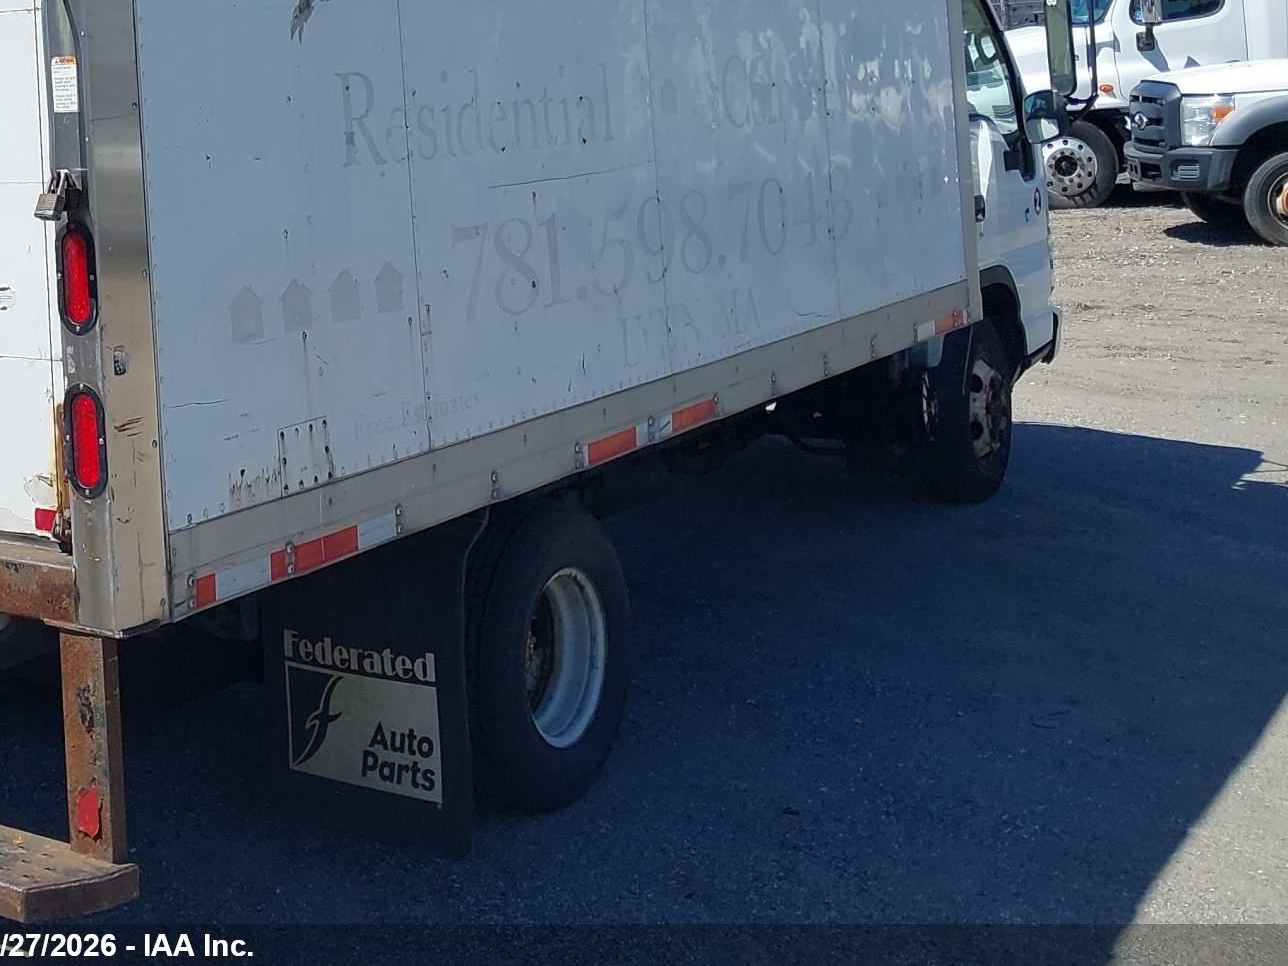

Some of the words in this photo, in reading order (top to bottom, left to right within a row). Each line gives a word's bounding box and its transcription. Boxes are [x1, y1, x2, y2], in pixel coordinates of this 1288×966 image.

[332, 60, 615, 168] Residential
[283, 628, 435, 683] Federated
[368, 721, 434, 759] Auto
[361, 749, 436, 792] Parts
